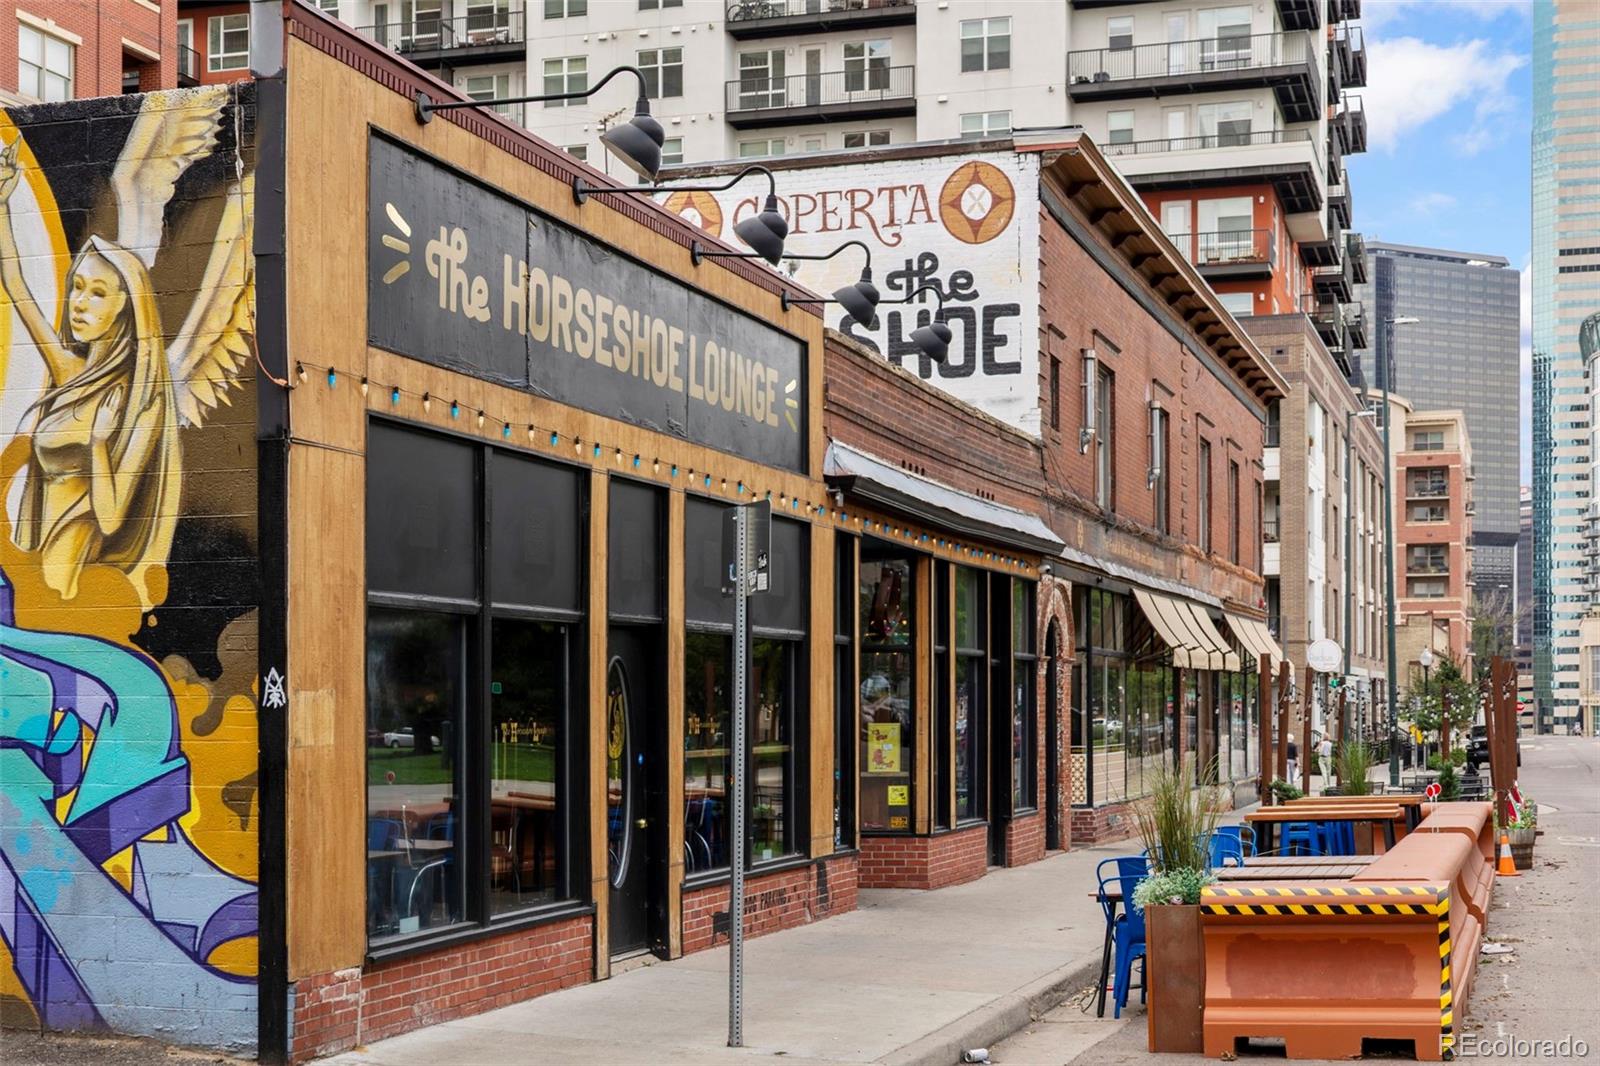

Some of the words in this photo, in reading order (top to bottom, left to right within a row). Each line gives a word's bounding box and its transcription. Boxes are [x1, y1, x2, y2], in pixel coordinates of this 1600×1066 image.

[425, 226, 491, 323] the
[503, 253, 684, 393] HORSESHOE
[690, 334, 779, 428] LOUNGE
[886, 251, 979, 304] the
